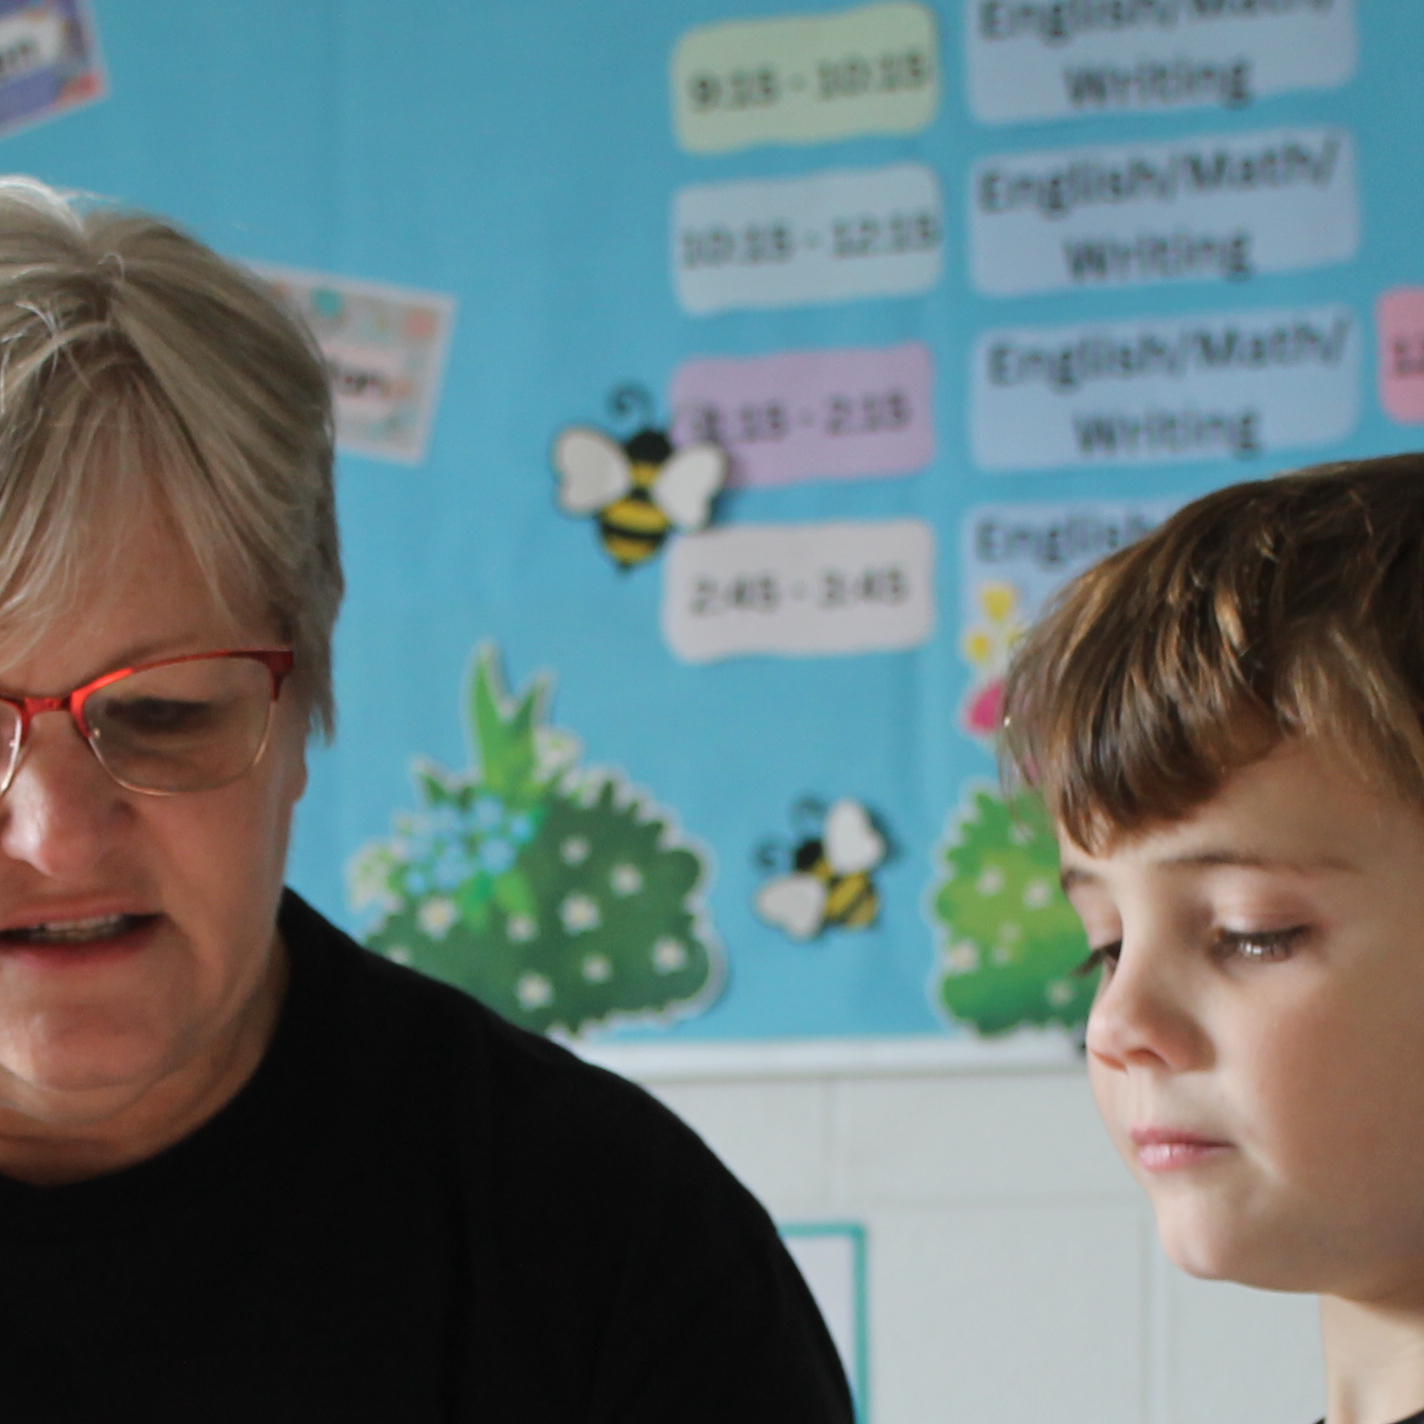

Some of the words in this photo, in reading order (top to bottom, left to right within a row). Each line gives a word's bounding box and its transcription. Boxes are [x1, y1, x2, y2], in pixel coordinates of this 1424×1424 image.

[687, 64, 779, 113] 9:15
[816, 46, 930, 100] 10:15
[1064, 55, 1253, 109] Writing
[978, 139, 1340, 221] English/Math/
[681, 220, 793, 270] 10:15
[831, 207, 939, 260] 12:15
[1064, 228, 1253, 283] Writing
[986, 311, 1350, 394] English/Math/
[826, 386, 910, 438] 2:15
[1074, 406, 1263, 460] Writing
[689, 572, 780, 617] 2:45
[820, 561, 908, 610] 3:45
